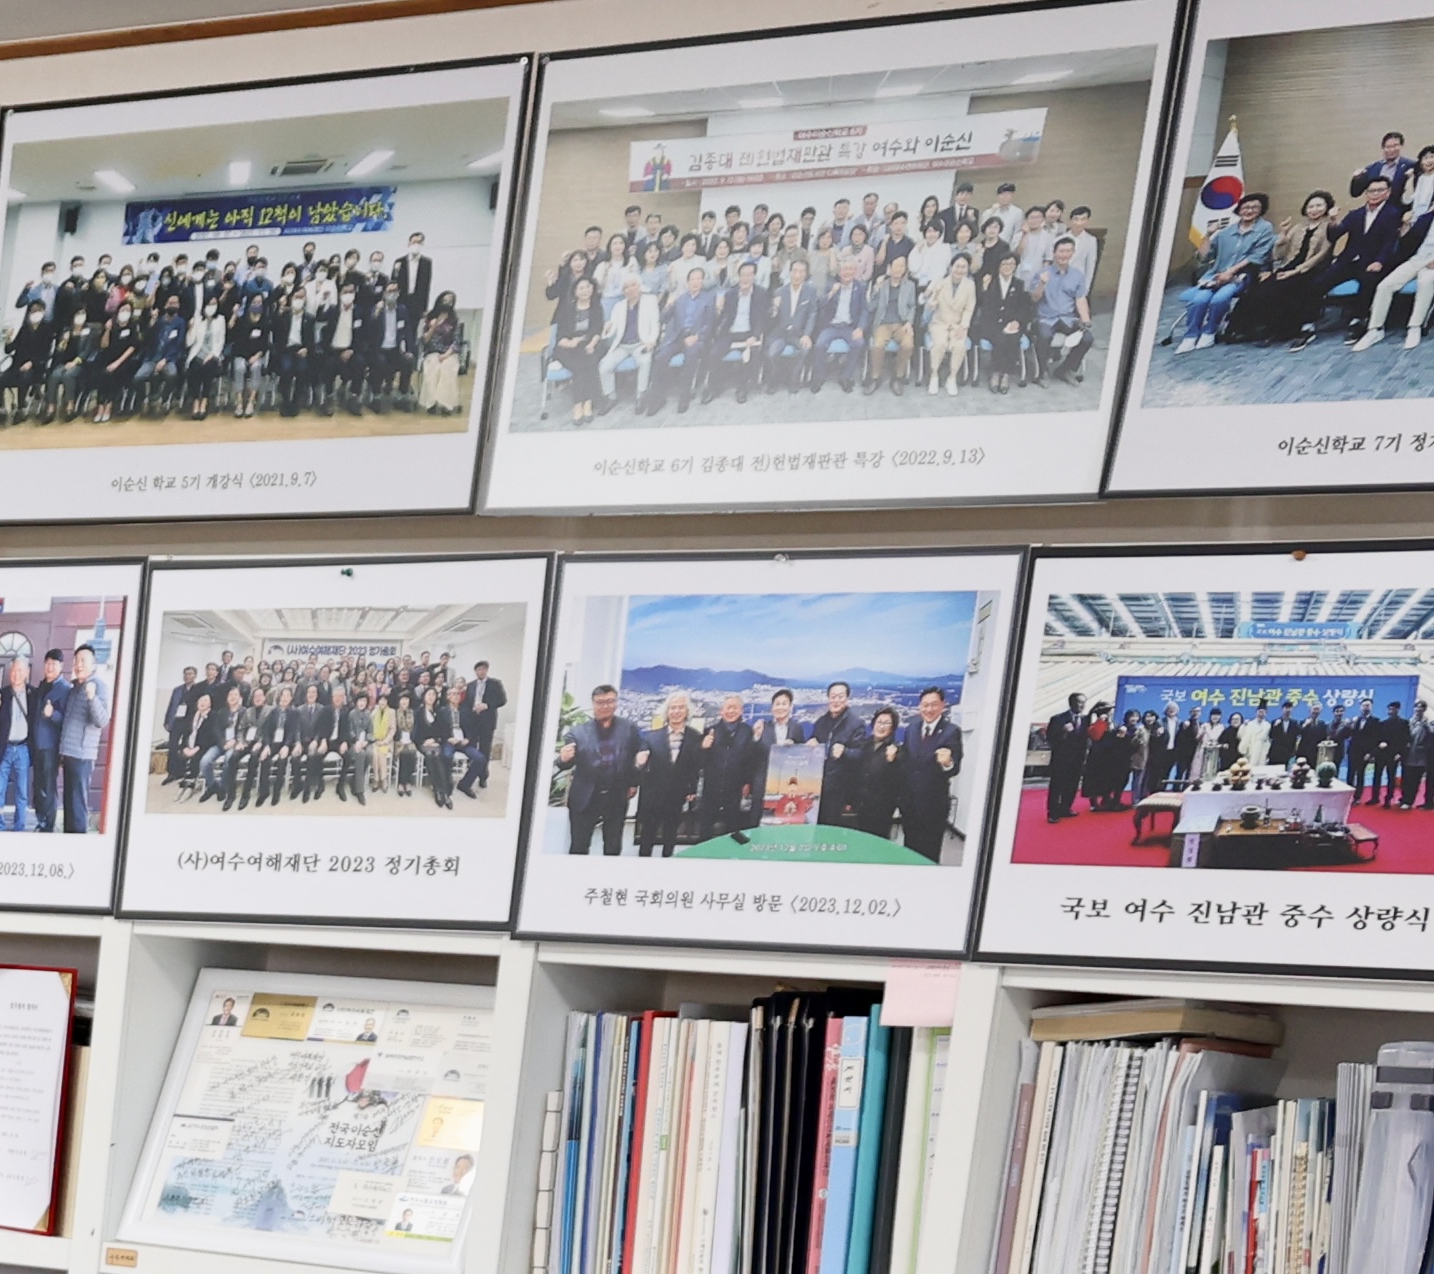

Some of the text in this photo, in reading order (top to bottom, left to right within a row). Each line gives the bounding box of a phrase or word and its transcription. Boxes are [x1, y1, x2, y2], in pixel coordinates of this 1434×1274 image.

[872, 137, 922, 157] 여수와
[926, 131, 974, 152] 이순신
[163, 208, 220, 232] 신에게는
[224, 205, 255, 228] 아직
[258, 203, 302, 227] 12척이
[1277, 434, 1367, 456] 이순신학교
[1373, 432, 1403, 454] 7기
[593, 457, 667, 476] 이순신학교
[671, 455, 695, 475] 6기
[700, 455, 745, 473] 김종대
[853, 450, 885, 469] 특강
[111, 474, 148, 492] 이순신
[152, 474, 177, 490] 학교
[180, 473, 201, 490] 5기
[205, 472, 243, 489] 개강식
[1161, 687, 1375, 708] 국보 여수 진남관 중수 상량식
[177, 850, 460, 877] (사)여수여해재단 2023 정기총회
[584, 887, 628, 907] 주철현
[634, 890, 695, 910] 국회의원
[701, 892, 747, 912] 사무실
[753, 894, 783, 914] 방문
[1060, 896, 1432, 934] 국보 여수 진남관 중수 상량식
